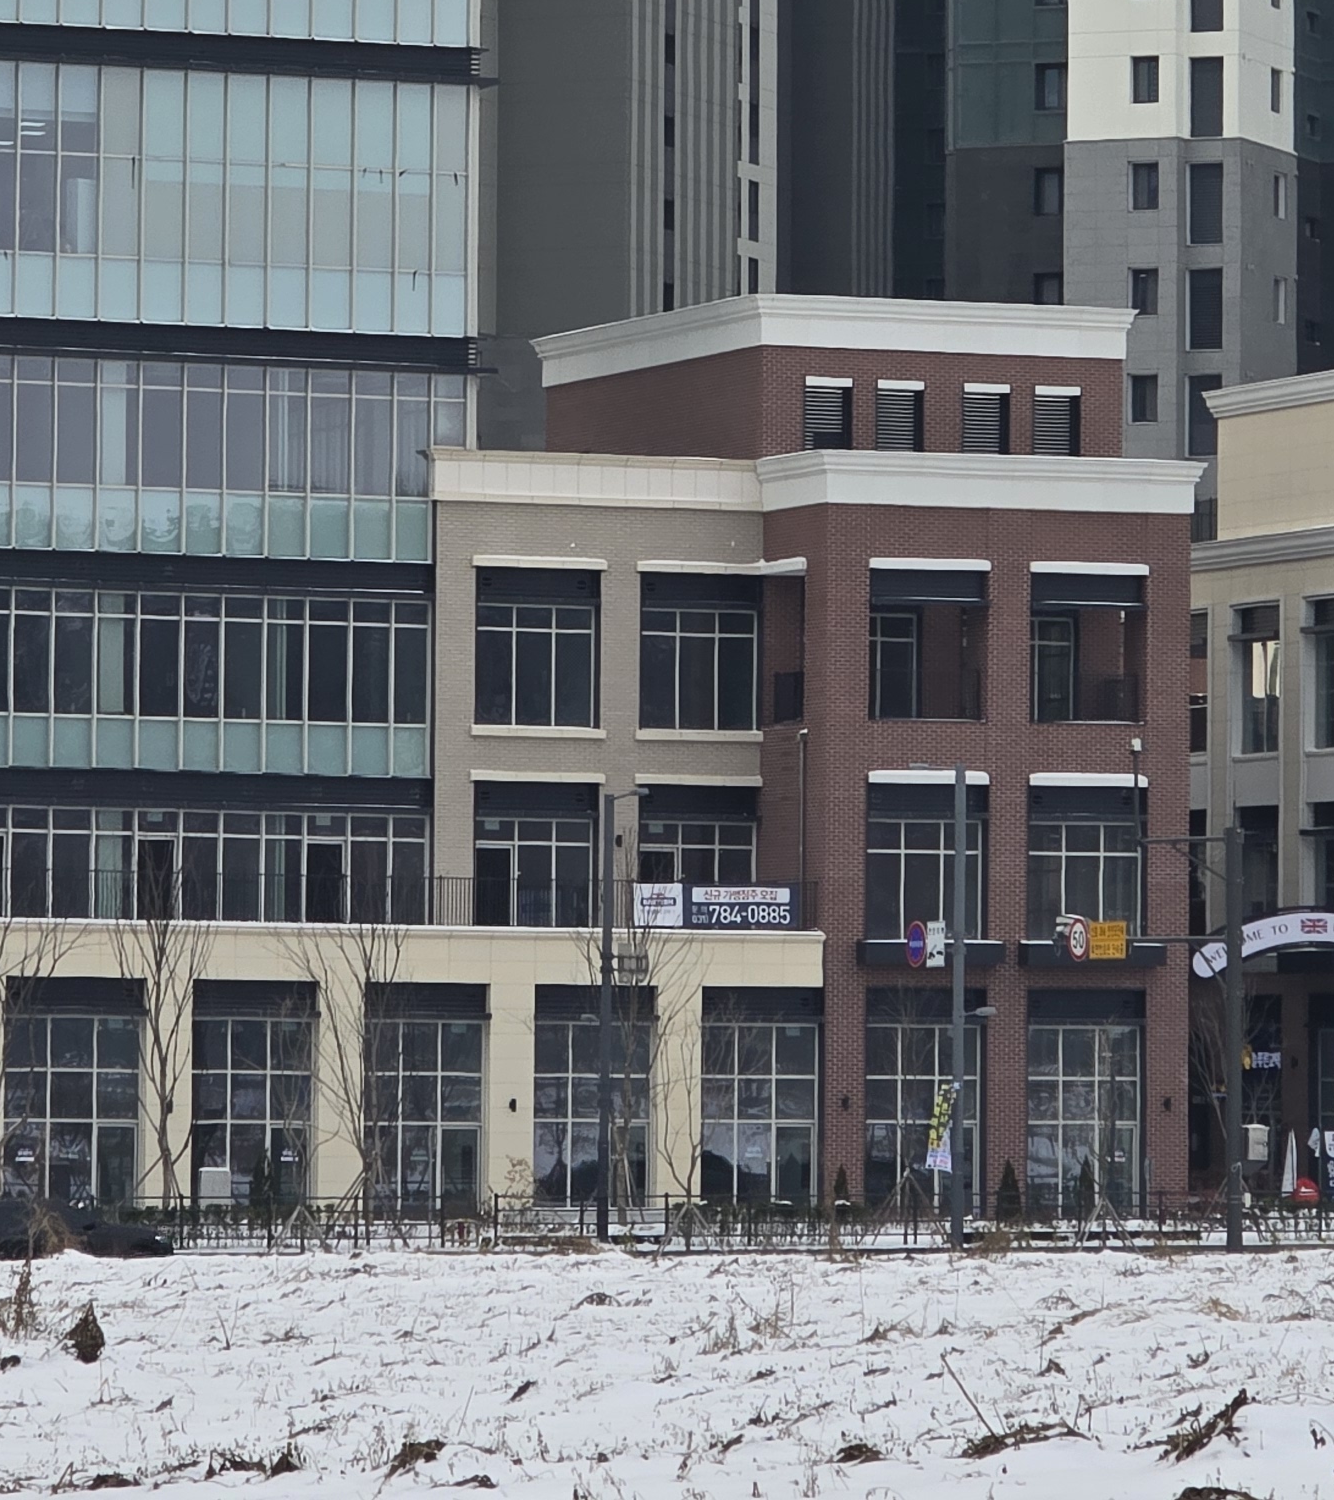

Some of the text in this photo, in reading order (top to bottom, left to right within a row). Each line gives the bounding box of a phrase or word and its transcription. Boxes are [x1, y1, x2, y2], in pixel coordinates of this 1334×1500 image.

[703, 888, 722, 901] 신규
[709, 905, 791, 925] 784-0885
[1271, 923, 1289, 936] TO
[1072, 930, 1085, 950] 50
